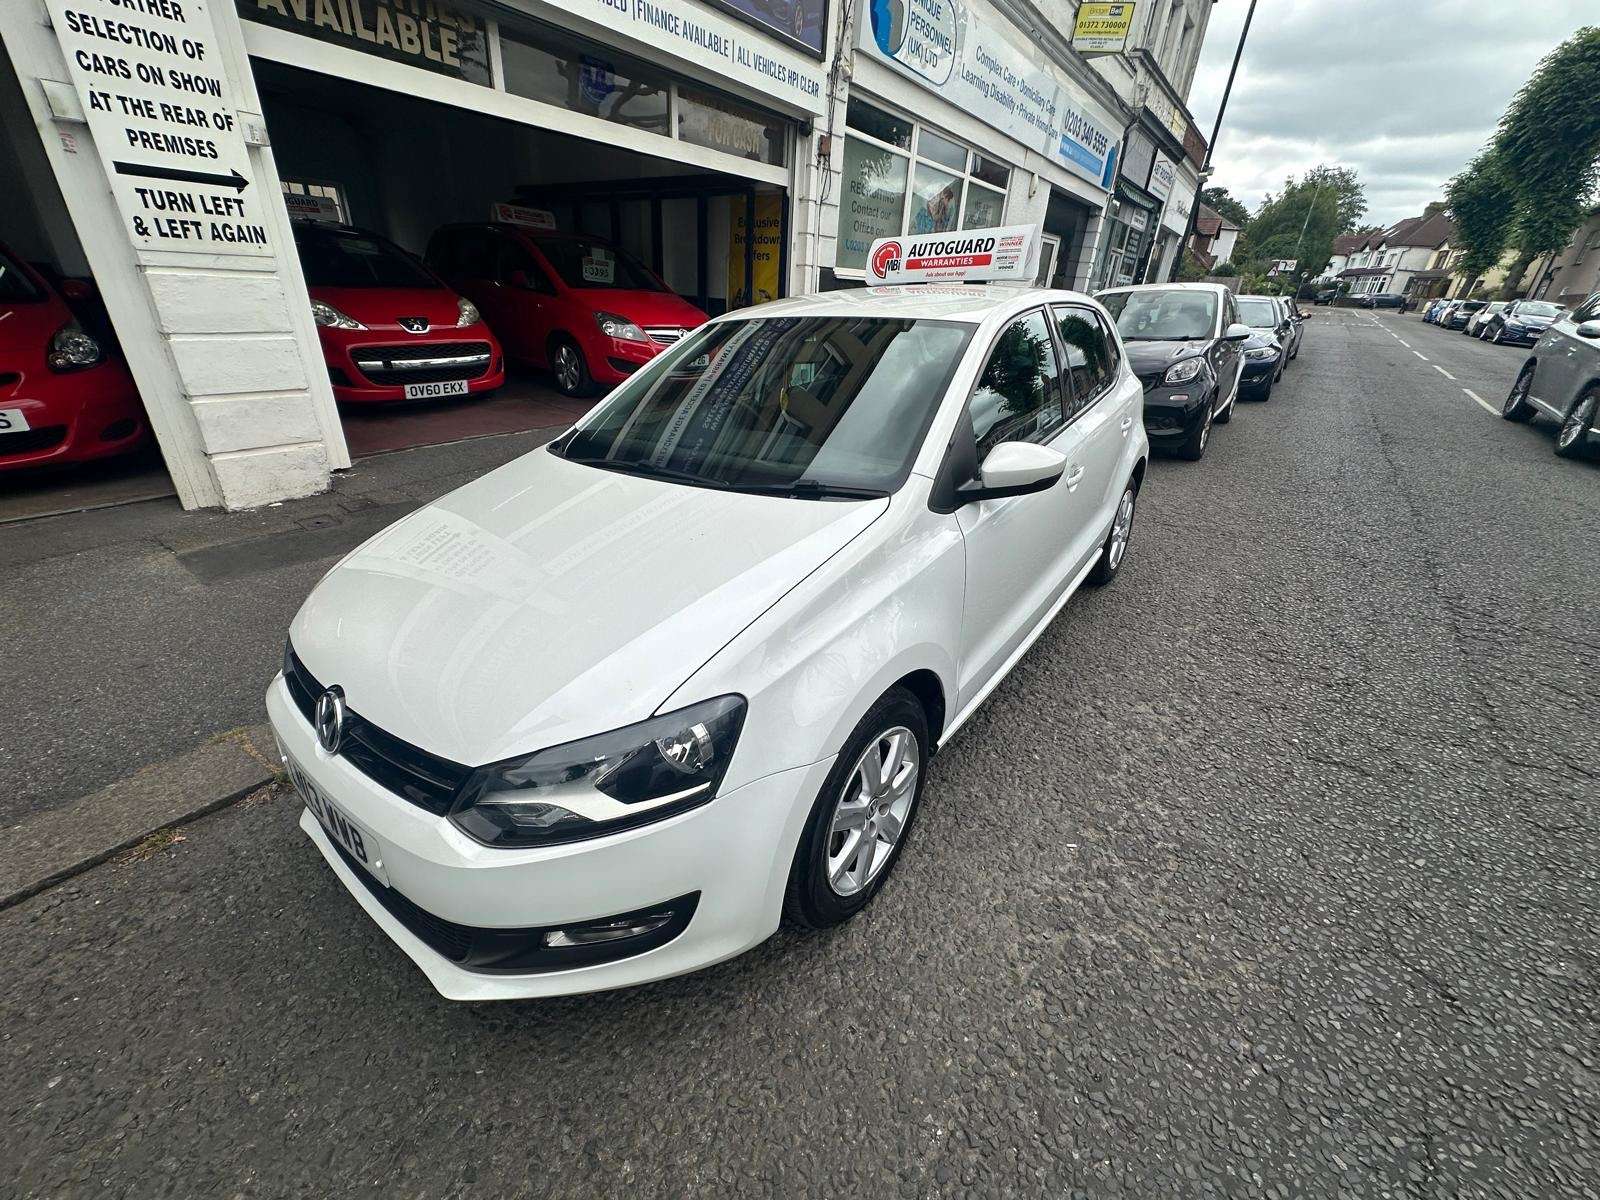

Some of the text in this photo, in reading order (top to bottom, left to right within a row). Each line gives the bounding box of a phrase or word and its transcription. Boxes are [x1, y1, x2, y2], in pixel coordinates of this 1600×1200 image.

[106, 0, 186, 23] RTHER
[1079, 21, 1099, 29] 01372
[66, 10, 205, 60] SELECTION OF
[910, 11, 953, 55] PERSONNEL
[637, 0, 680, 36] FINANCE
[682, 20, 729, 58] AVAILABLE
[737, 46, 751, 68] ALL
[754, 53, 786, 83] VEHICLES
[788, 69, 799, 88] HPI
[801, 75, 819, 98] CLEAR
[908, 36, 938, 68] (UK) LTD
[76, 50, 221, 97] CARS ON SHOW
[976, 45, 1056, 117] Complex Care Domiciliary Care
[961, 63, 990, 98] Learning
[990, 83, 1015, 114] Disability
[1019, 103, 1036, 125] Private
[90, 91, 233, 131] AT THE REAR OF
[1065, 108, 1082, 138] 0203
[126, 128, 218, 159] PREMISES
[135, 187, 244, 217] TURN LEFT
[852, 200, 891, 220] Contact our
[133, 215, 267, 244] & LEFT AGAIN
[738, 217, 779, 228] Elusive
[853, 220, 874, 235] Office
[908, 238, 995, 258] AUTOGUARD
[921, 257, 973, 267] WARRANTIES
[410, 381, 464, 397] OV60 EKX
